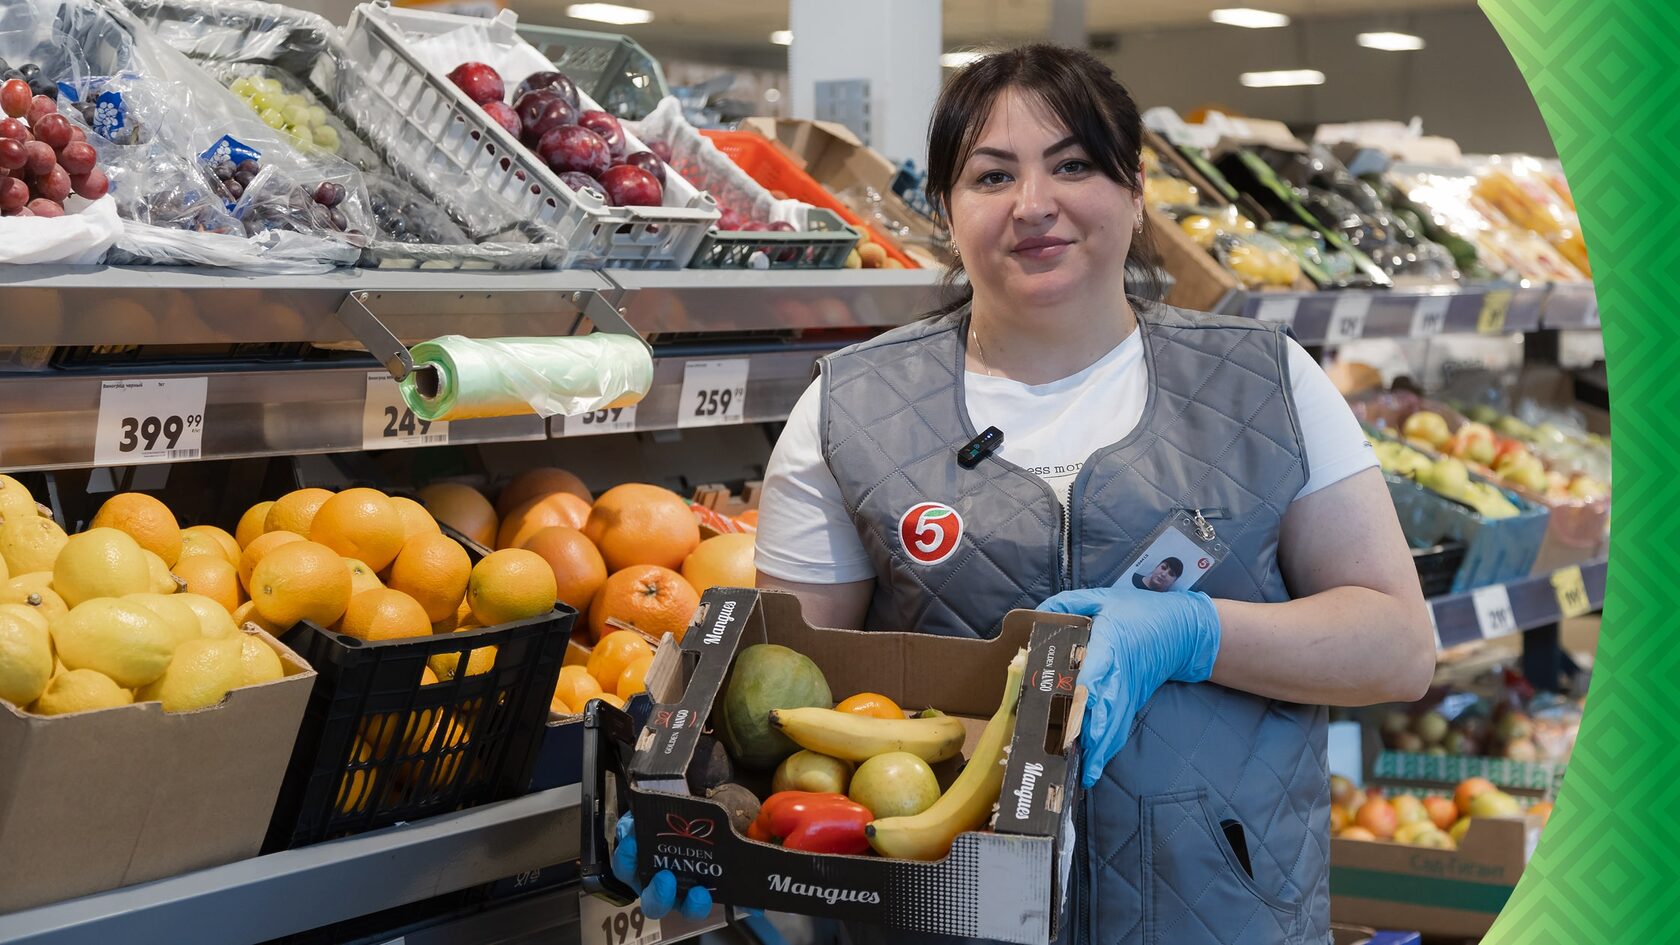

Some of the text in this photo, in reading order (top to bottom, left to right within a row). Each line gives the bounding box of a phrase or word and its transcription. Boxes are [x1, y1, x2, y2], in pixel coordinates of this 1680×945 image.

[694, 388, 732, 416] 259
[119, 414, 202, 453] 399 99
[915, 508, 951, 553] 5
[703, 600, 737, 645] Mangues
[1039, 645, 1056, 692] GOLDEN MANGO
[664, 709, 689, 755] GOLDEN MANGO
[1013, 761, 1044, 820] Mangues
[653, 854, 723, 877] MANGO
[657, 843, 713, 860] GOLDEN
[767, 874, 881, 905] Mangues
[601, 906, 646, 945] 199
